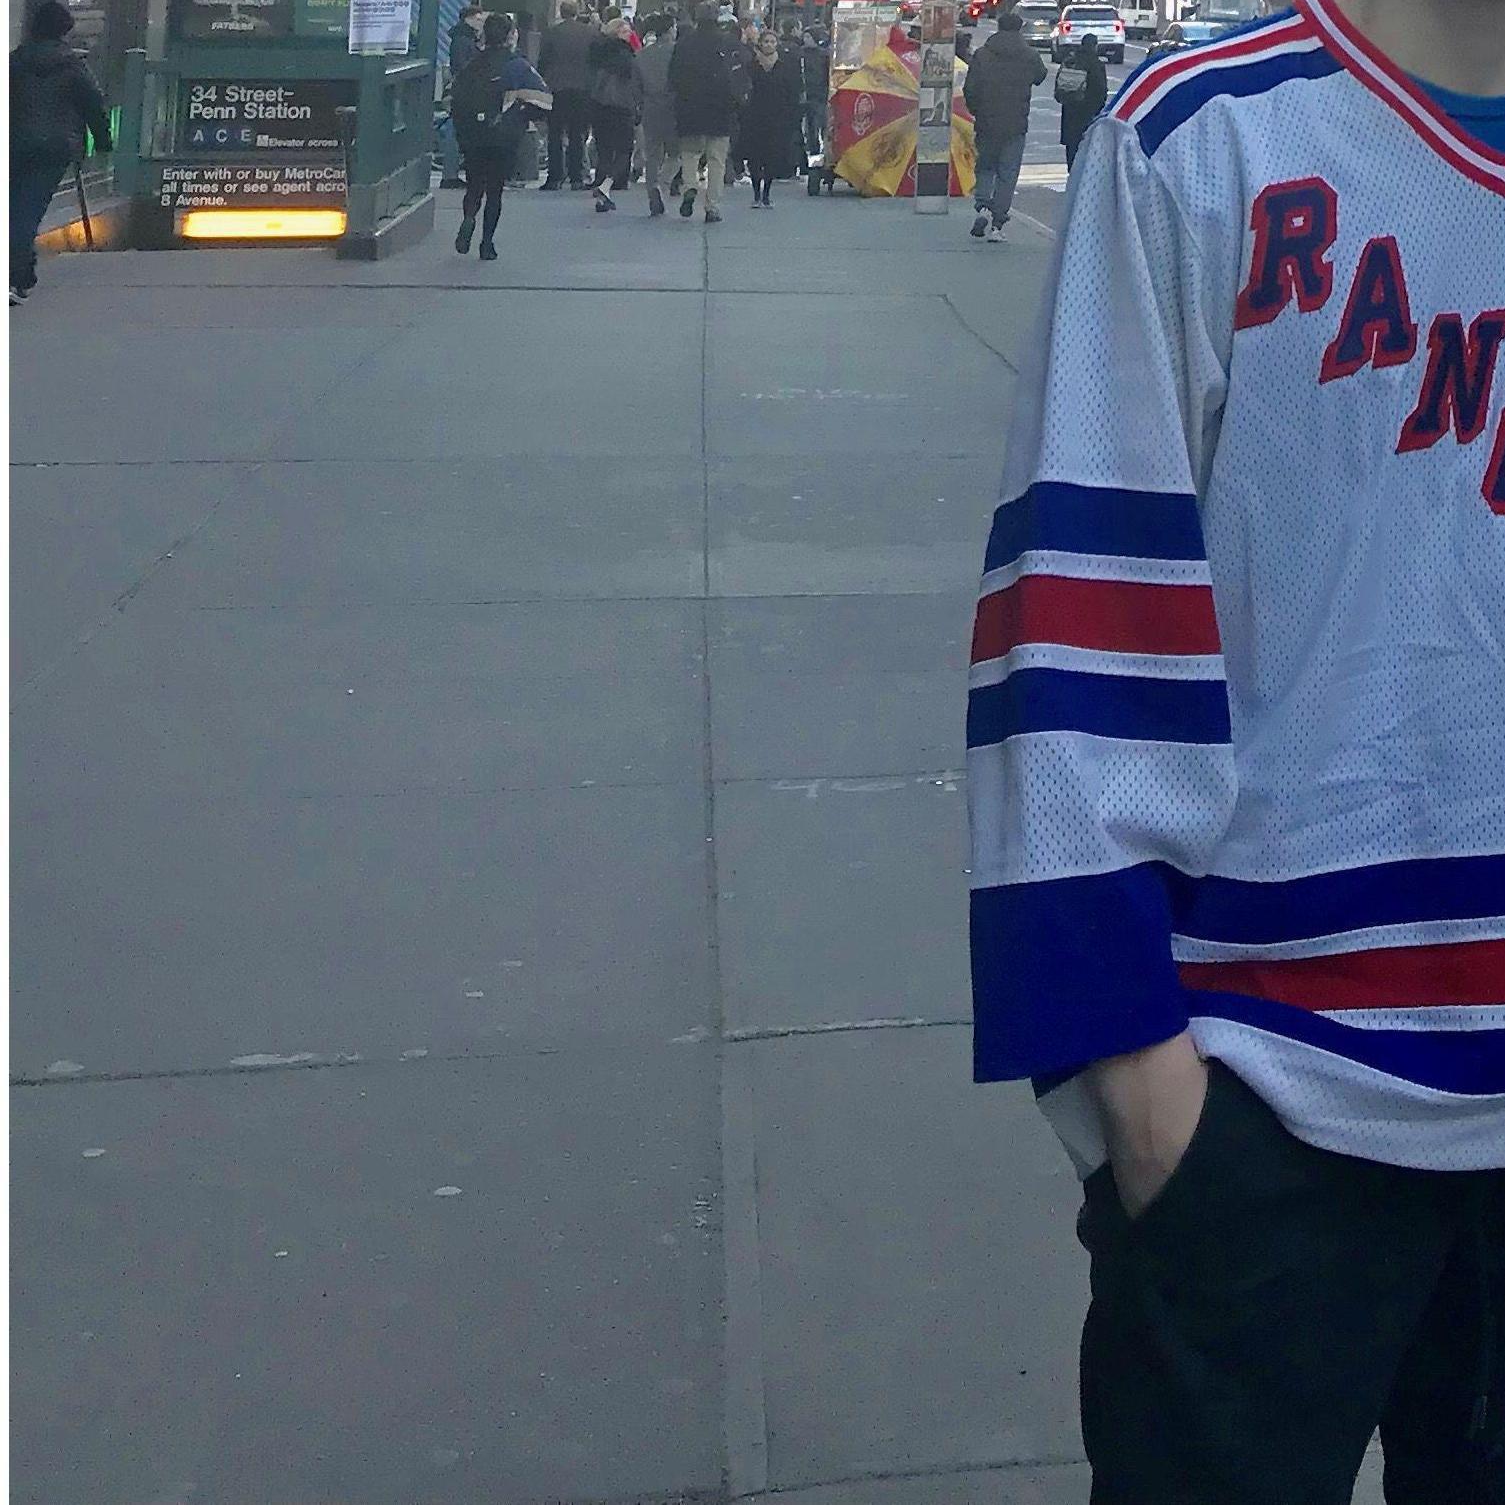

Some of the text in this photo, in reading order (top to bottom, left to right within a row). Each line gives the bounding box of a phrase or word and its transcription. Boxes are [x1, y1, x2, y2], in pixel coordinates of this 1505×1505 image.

[191, 86, 217, 103] 34
[189, 102, 312, 120] Penn Station
[193, 129, 252, 143] A C E
[162, 168, 198, 180] Enter
[204, 168, 231, 180] with
[236, 170, 250, 180] or
[255, 168, 280, 181] buy
[161, 183, 177, 194] all
[183, 182, 219, 194] times
[223, 183, 238, 194] or
[243, 183, 269, 194] see
[273, 183, 311, 195] agent
[160, 194, 228, 206] 8 Avenue.
